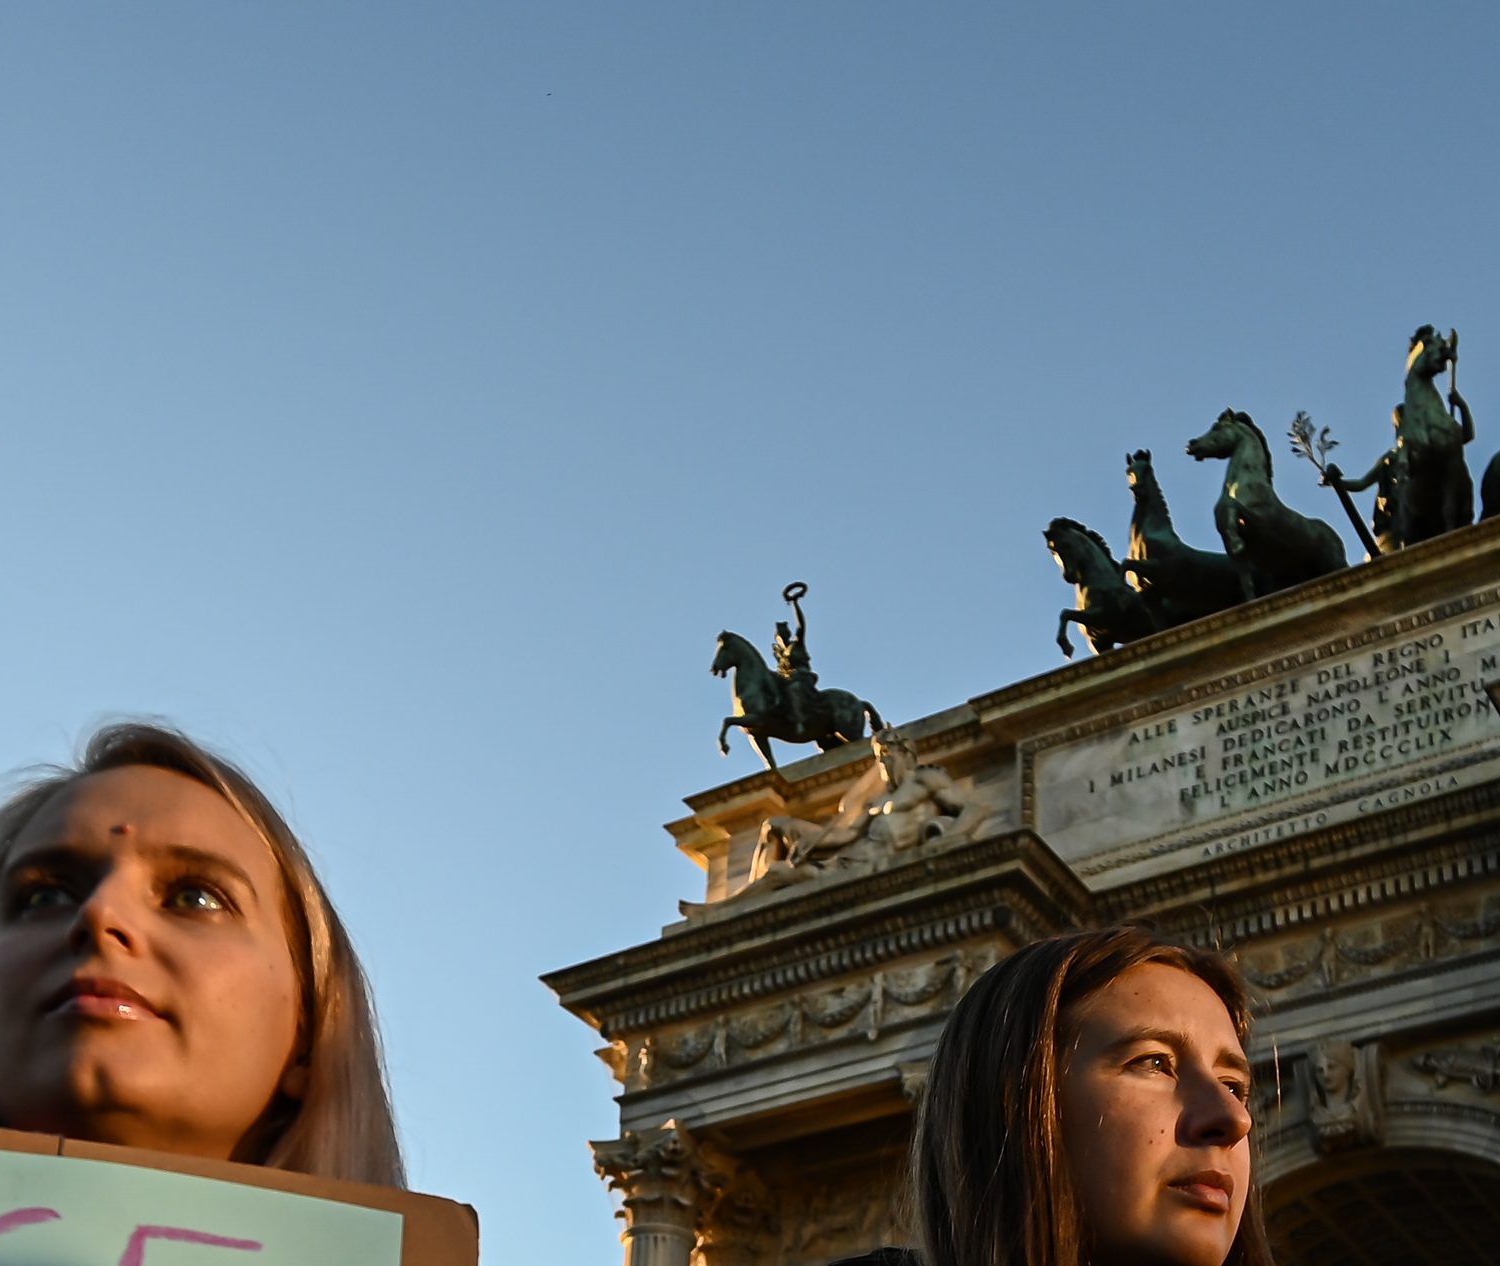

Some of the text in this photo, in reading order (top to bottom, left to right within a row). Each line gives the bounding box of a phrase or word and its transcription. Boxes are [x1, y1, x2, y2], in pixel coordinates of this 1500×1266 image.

[1088, 780, 1095, 793] I
[1110, 746, 1206, 787] MILANESI
[1223, 699, 1360, 752] DEDICARONO
[1402, 667, 1461, 696] ANNO
[1129, 719, 1177, 745] ALLE
[1193, 679, 1299, 725] SPERANZE
[1317, 663, 1355, 685] DEL
[1373, 634, 1443, 667] REGNO
[1216, 650, 1450, 736] AUSPICE NAPOLEONE I
[1180, 697, 1491, 801] FELICEMENTE RESTITUIRON
[1196, 765, 1205, 779] E
[1222, 727, 1326, 771] FRANCATI
[1347, 714, 1375, 732] DA
[1248, 771, 1309, 800] ANNO
[1324, 727, 1452, 778] MDCCCLIX
[1202, 775, 1459, 859] ARCHITETTO CAGNOLA
